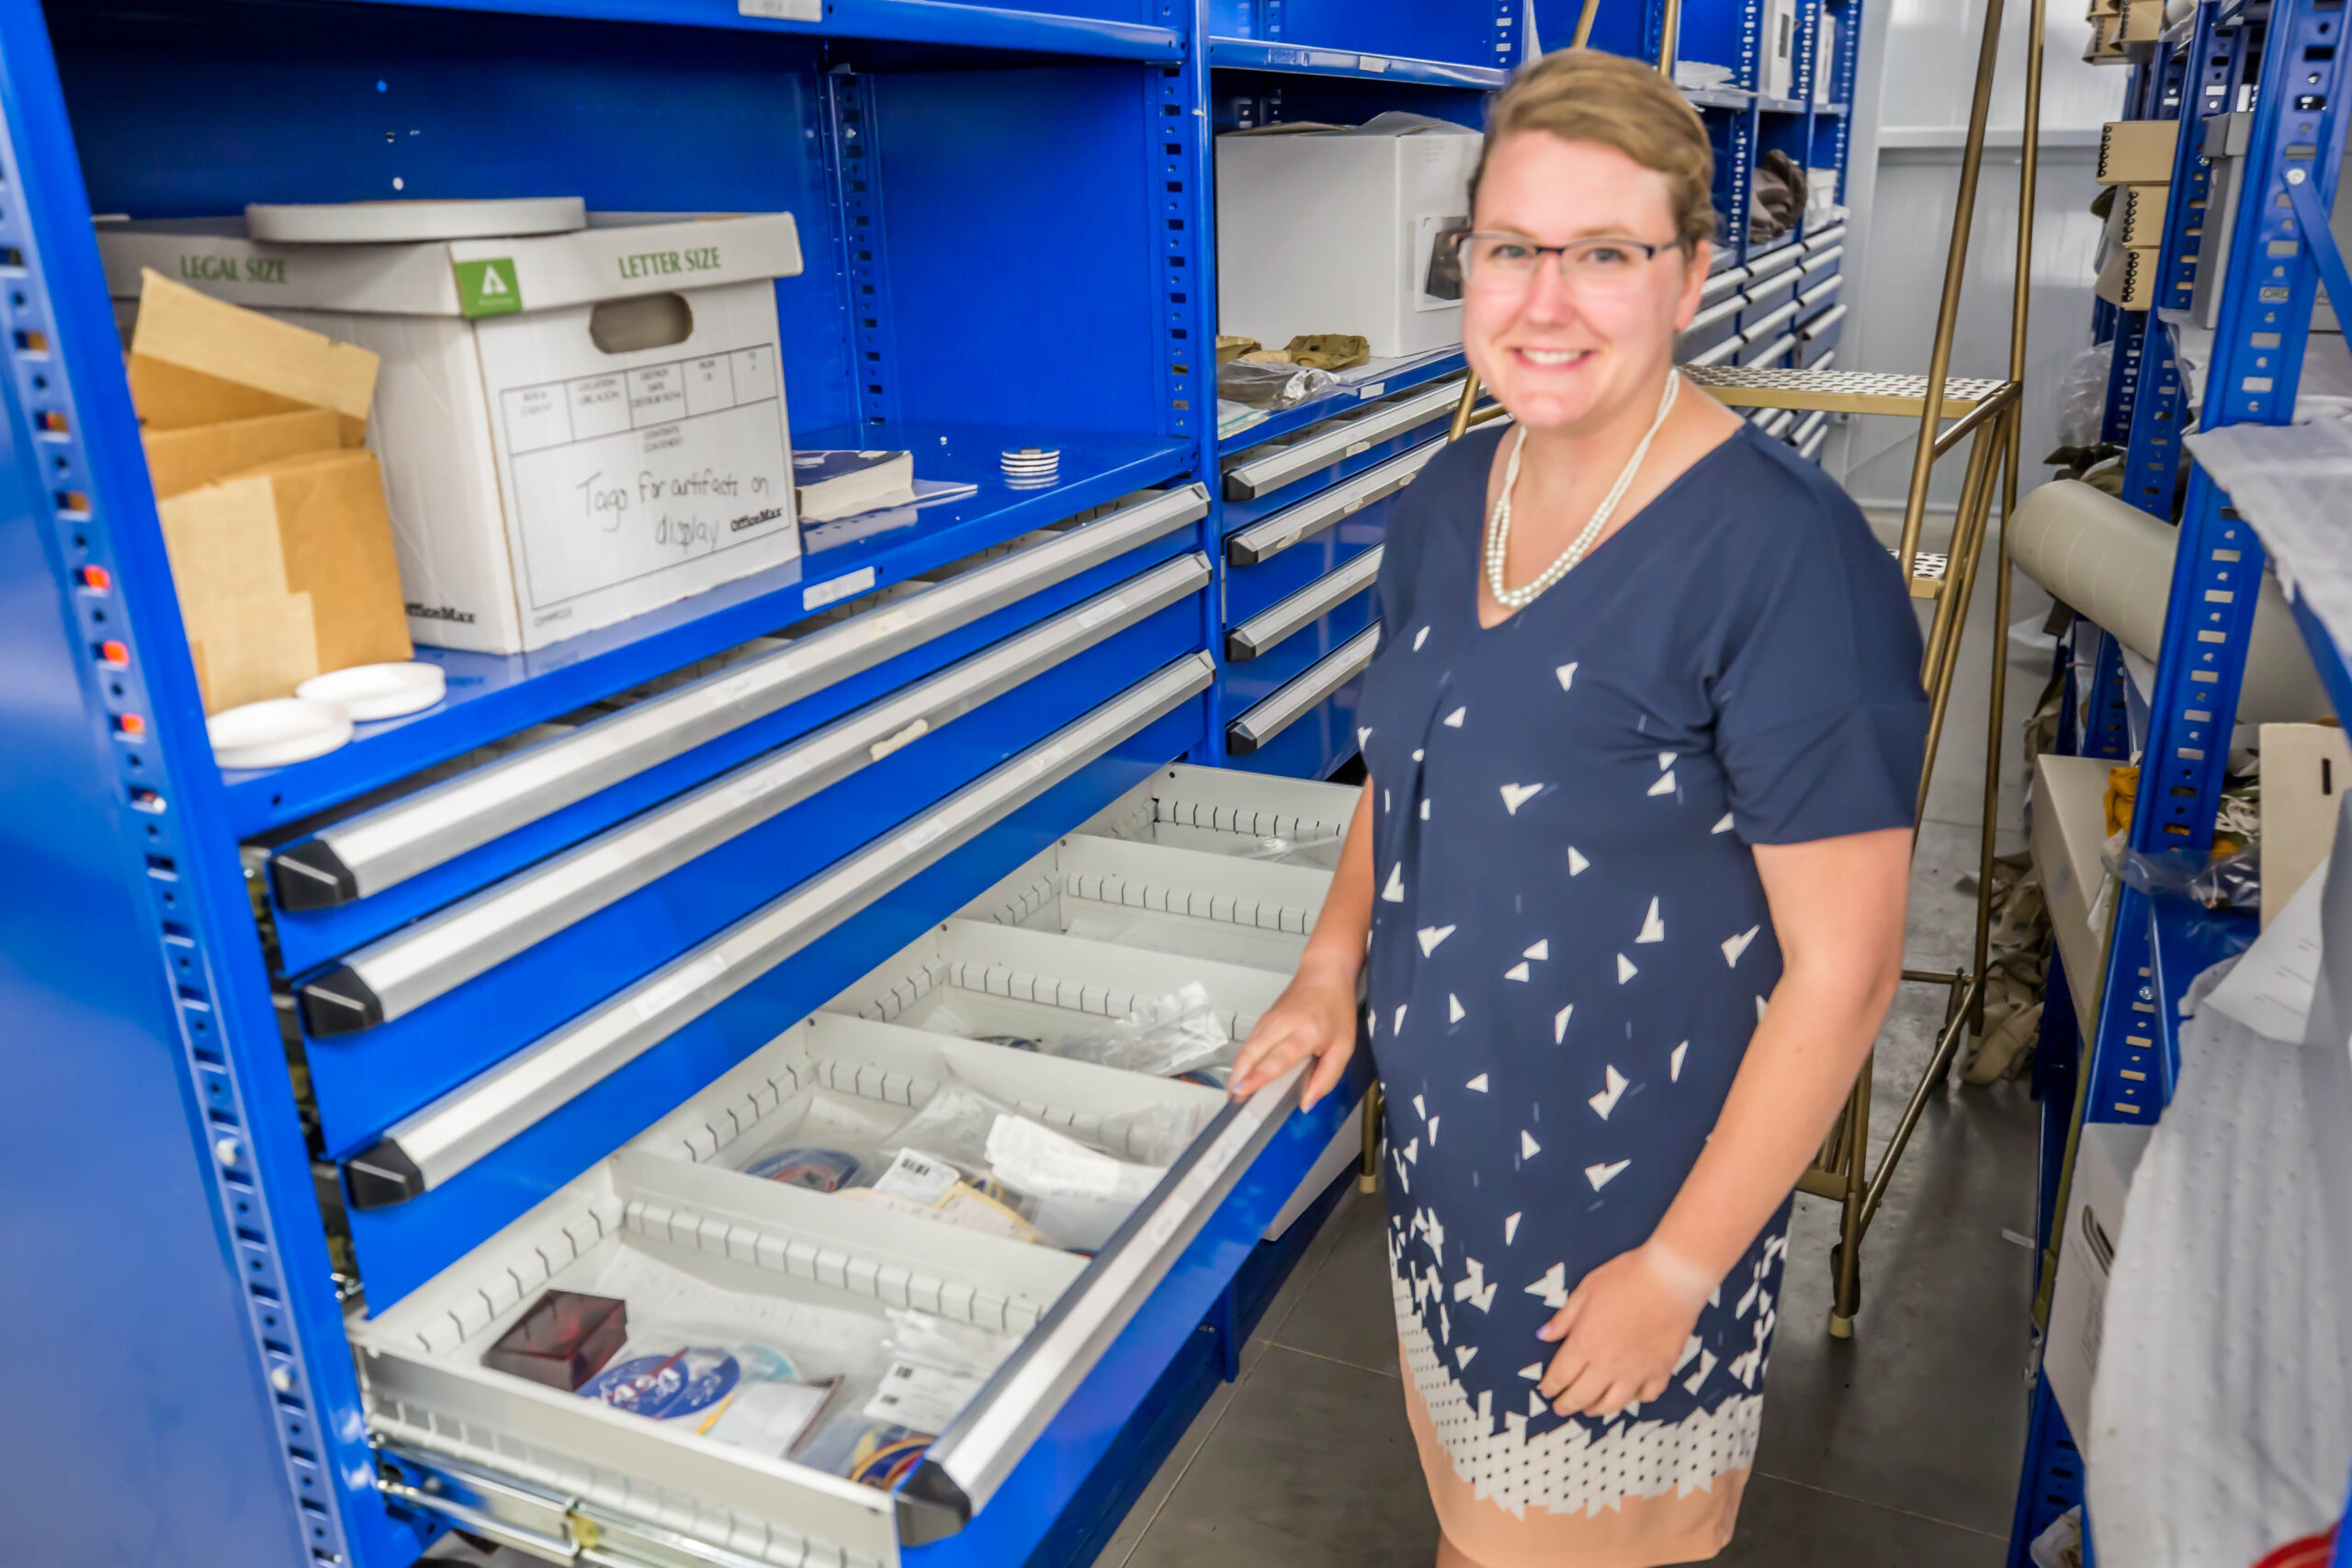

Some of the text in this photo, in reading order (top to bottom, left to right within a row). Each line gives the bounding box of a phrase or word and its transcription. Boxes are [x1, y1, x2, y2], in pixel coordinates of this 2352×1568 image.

[180, 254, 288, 285] LEGAL SIZE
[617, 246, 722, 279] LETTER SIZE
[751, 476, 769, 497] on
[730, 507, 783, 533] OfficeMax
[655, 513, 720, 556] display
[405, 602, 475, 625] fficeMax
